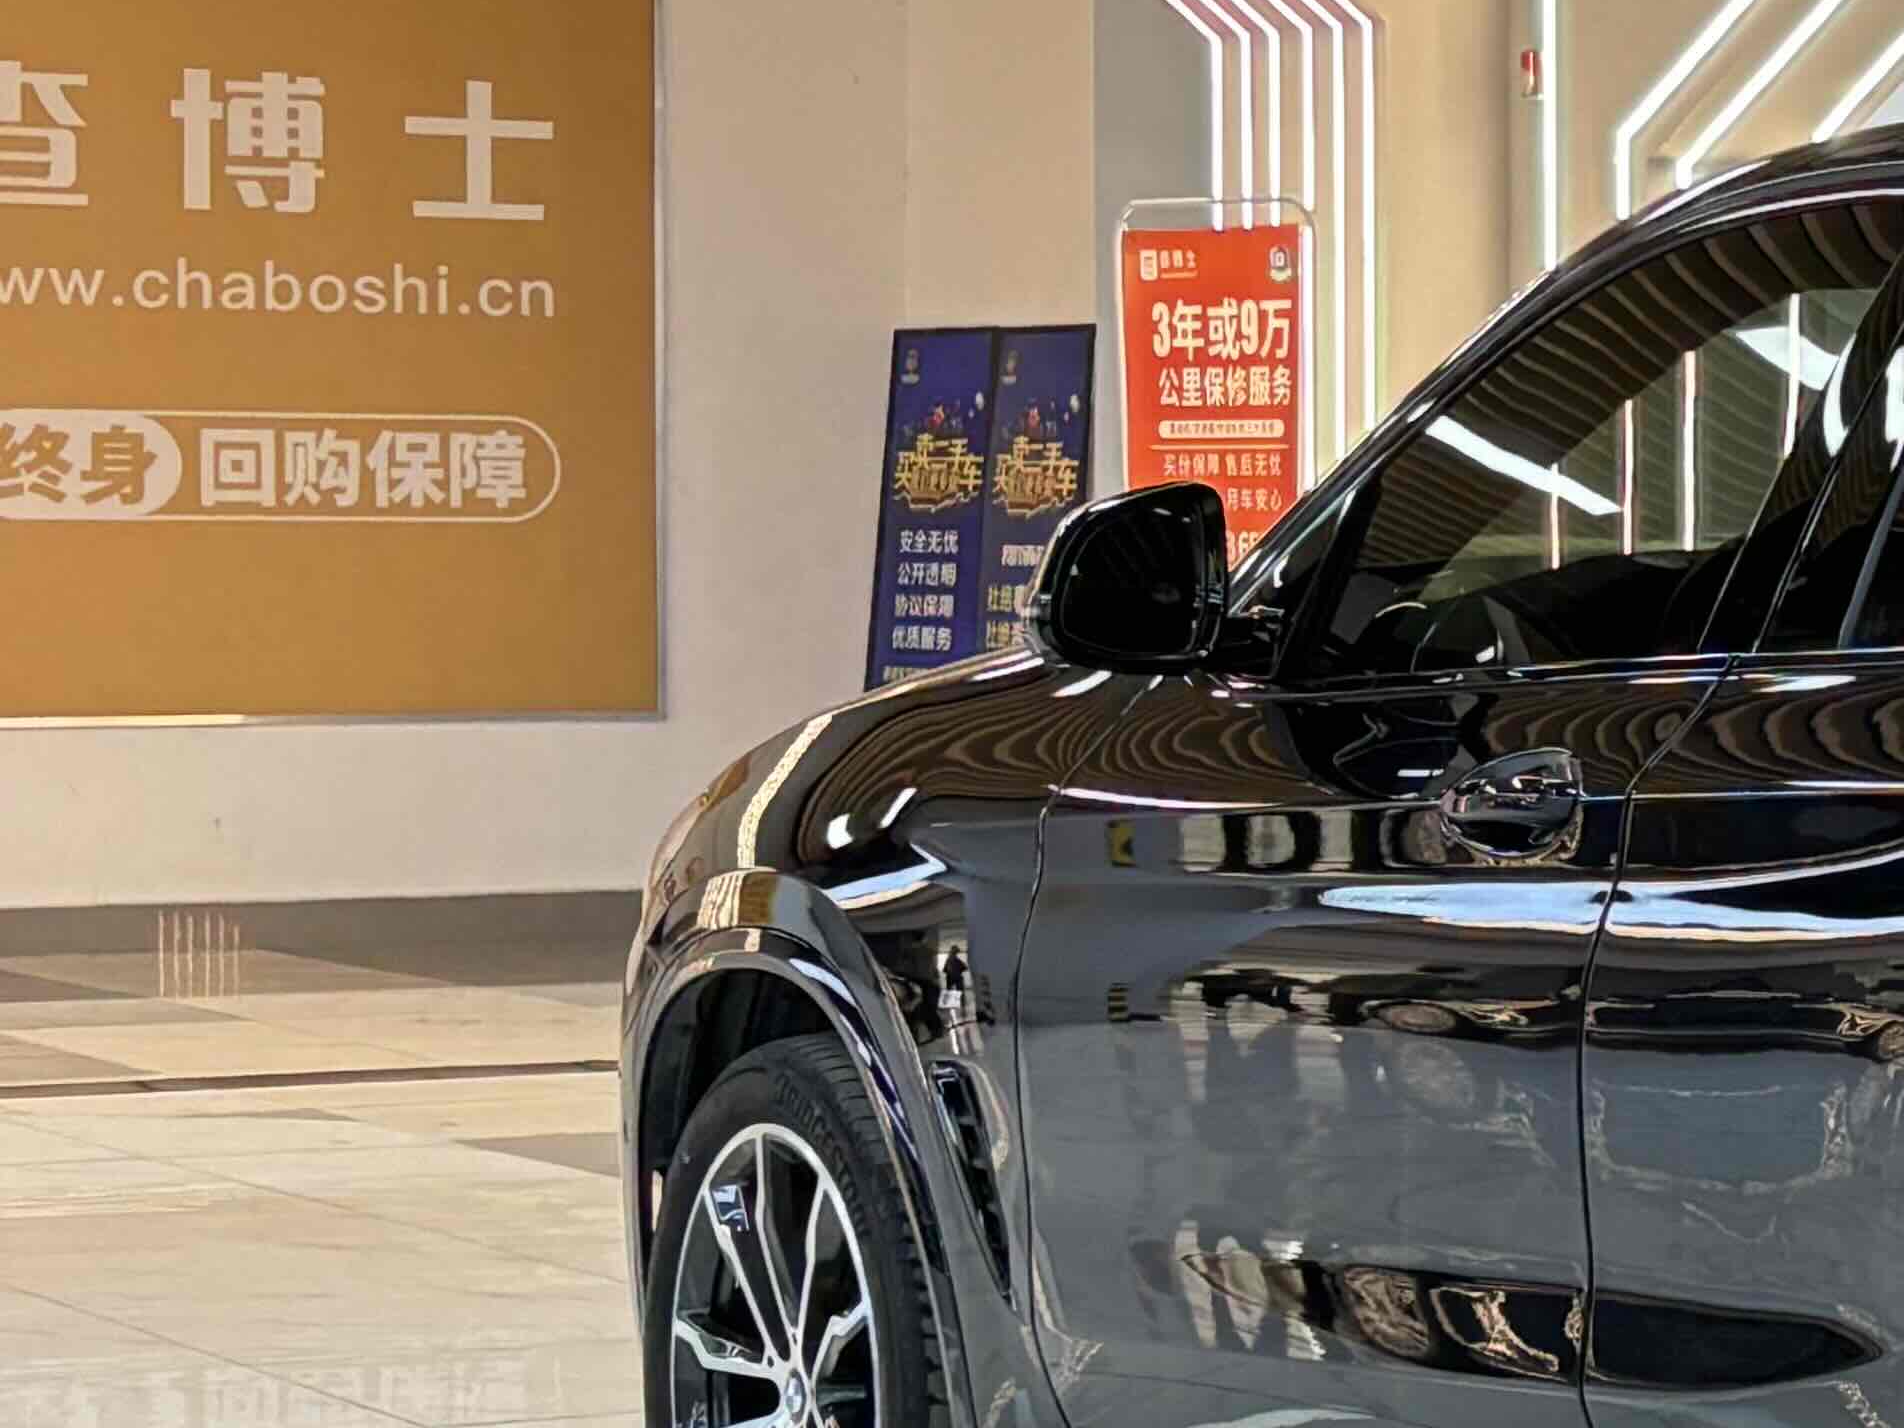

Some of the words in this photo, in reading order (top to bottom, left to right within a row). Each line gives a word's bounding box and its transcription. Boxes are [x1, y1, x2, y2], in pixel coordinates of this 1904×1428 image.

[0, 60, 554, 221] 查博士
[1152, 297, 1292, 361] 3年或9万
[1159, 364, 1291, 406] 公里保修服务
[0, 424, 158, 506] 终身
[201, 428, 527, 509] 回购保障
[900, 529, 959, 554] 安全无忧
[898, 561, 957, 586] 公开透明
